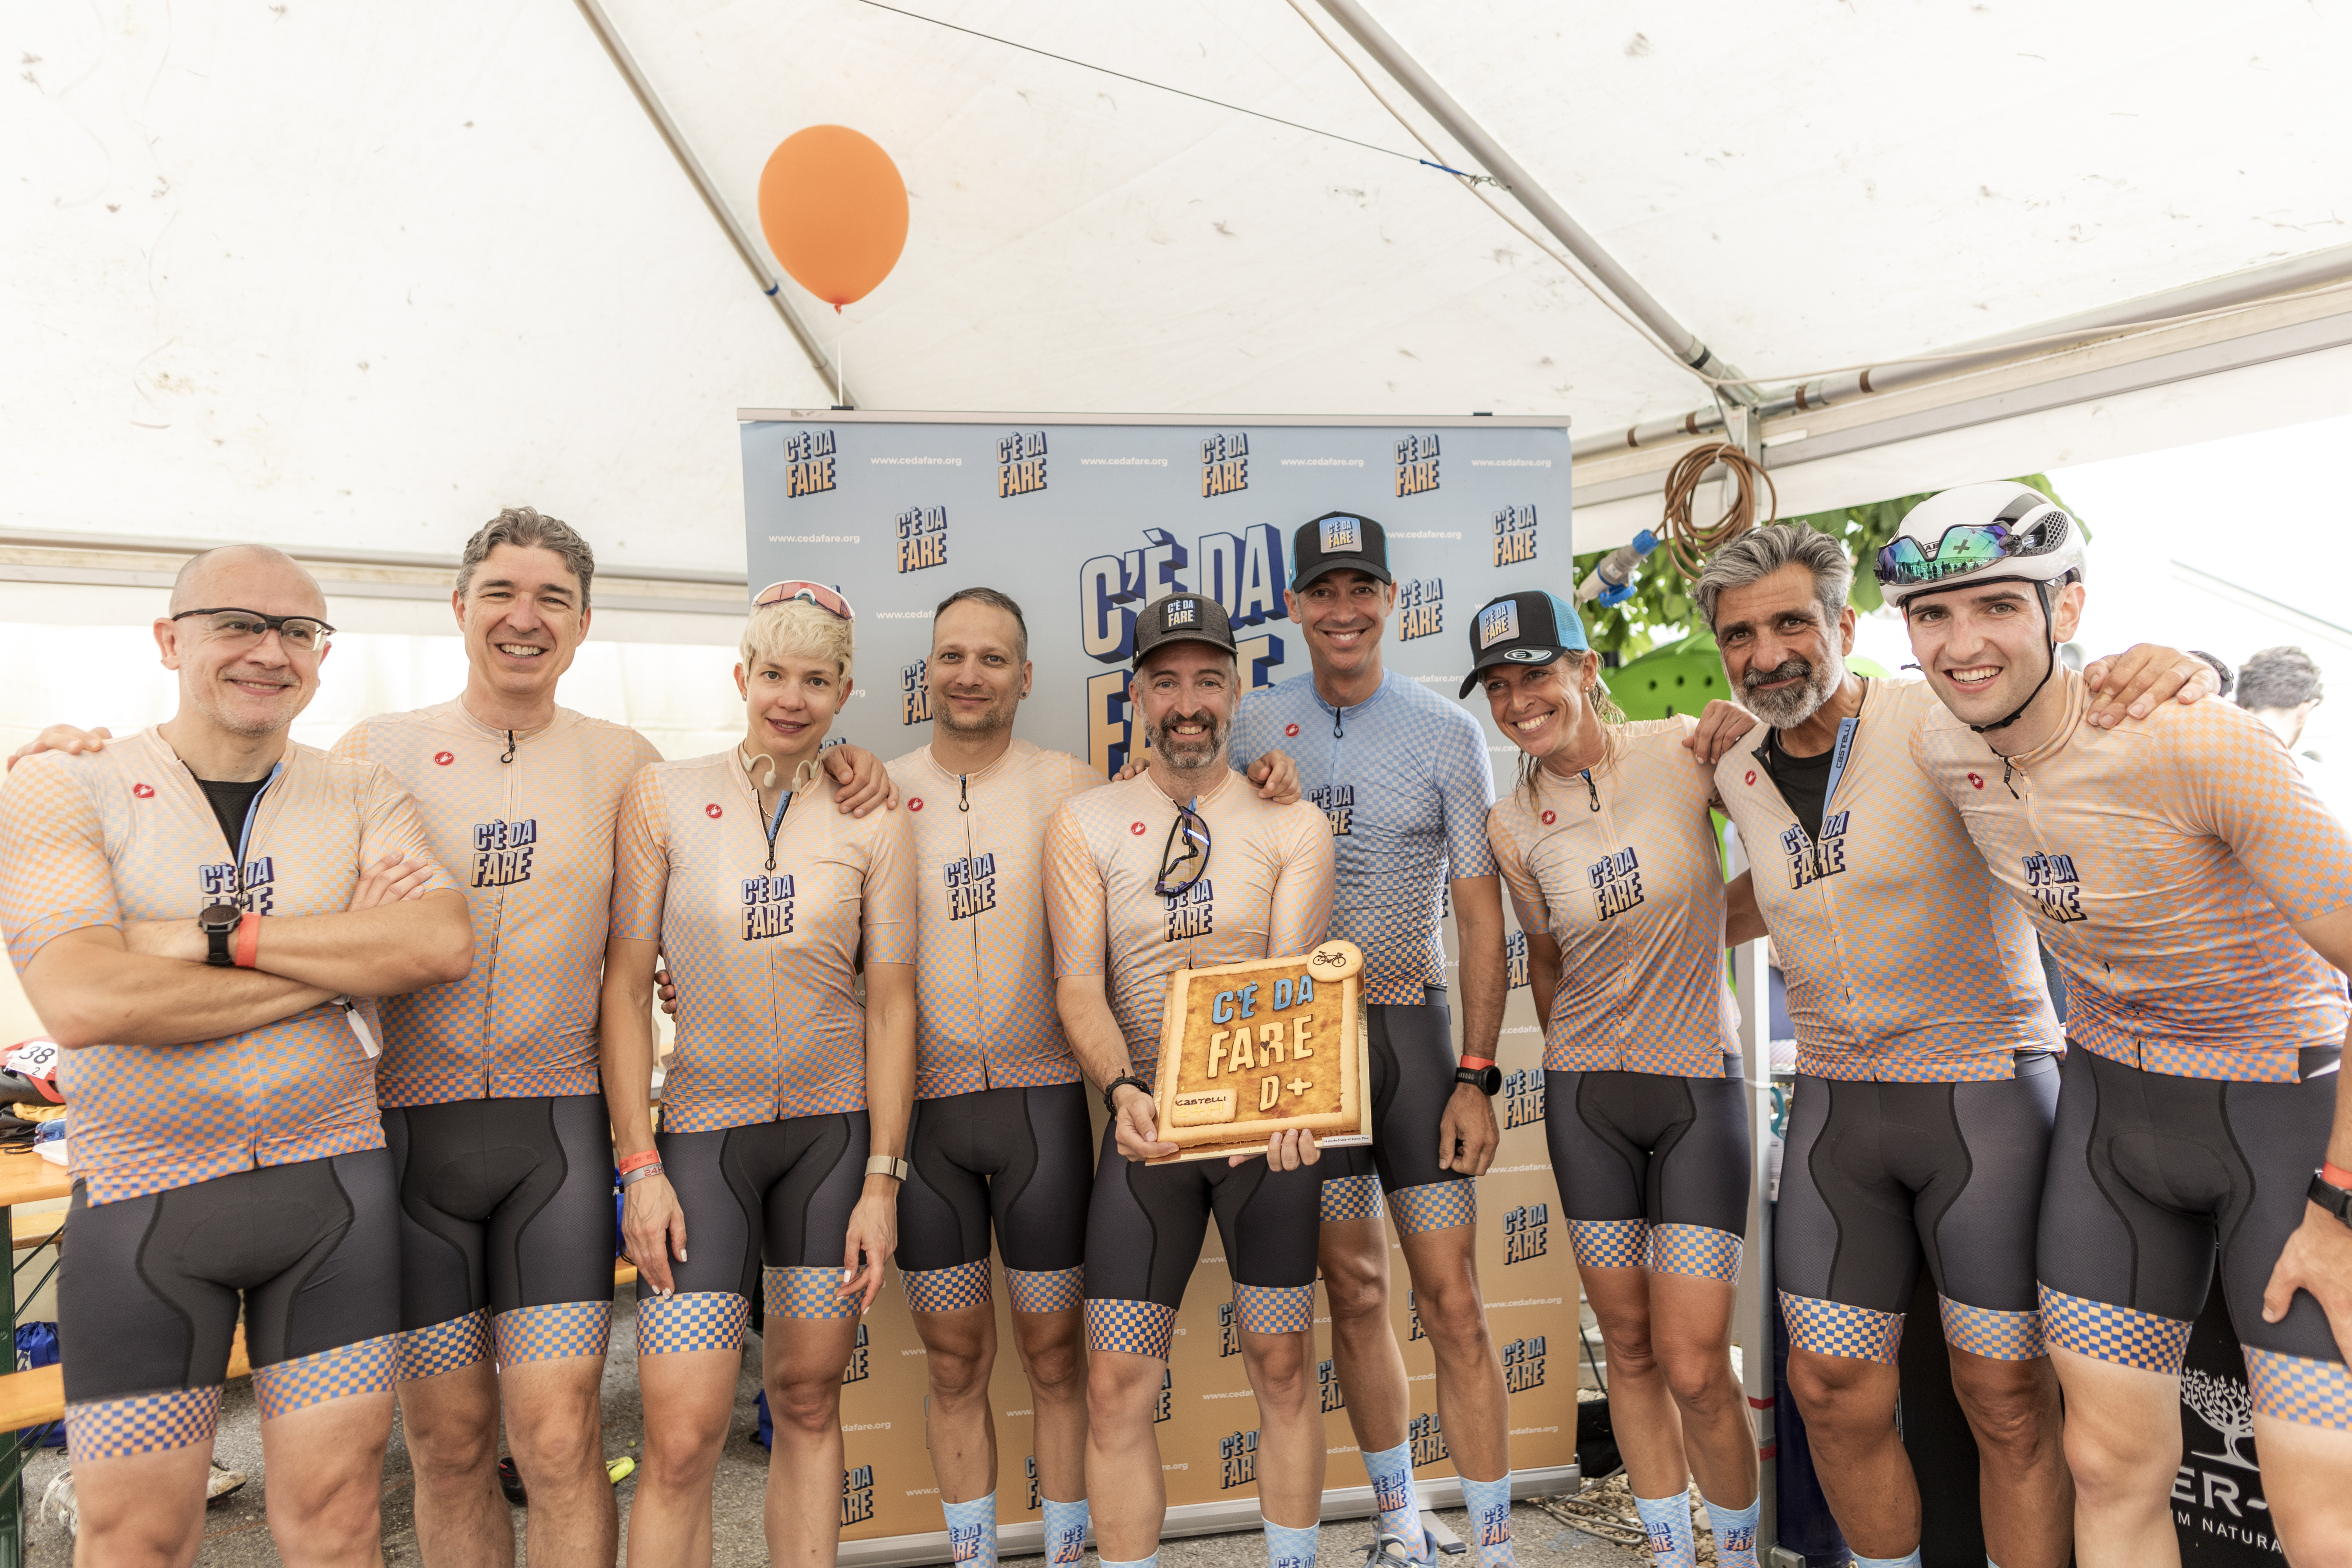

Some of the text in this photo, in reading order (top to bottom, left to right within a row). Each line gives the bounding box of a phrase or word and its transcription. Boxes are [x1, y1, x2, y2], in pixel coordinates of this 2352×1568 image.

[783, 429, 836, 462] C'È DA
[871, 456, 962, 466] www.cedafare.org
[996, 431, 1047, 464] C'È DA
[1201, 432, 1249, 464] C'È DA
[1394, 433, 1440, 464] C'È DA
[1081, 457, 1168, 466] www.cedafare.org
[1281, 458, 1364, 467] www.cedafare.org
[1472, 458, 1552, 467] www.cedafare.org
[786, 457, 836, 498] FARE
[999, 457, 1047, 498] FARE
[1202, 458, 1248, 498] FARE
[1396, 458, 1440, 497] FARE
[895, 505, 947, 539] C'È DA
[1328, 520, 1353, 535] C'È DA
[1492, 504, 1537, 535] C'È DA
[769, 534, 860, 544] www.cedafare.org
[897, 532, 947, 573] FARE
[1328, 531, 1353, 548] FARE
[1493, 529, 1537, 567] FARE
[1199, 522, 1290, 632] DA
[1168, 599, 1195, 613] C'È DA
[1398, 578, 1443, 609] C'È DA
[876, 610, 937, 618] www.cedafa
[1168, 609, 1195, 627] FARE
[1399, 603, 1443, 641] FARE
[1484, 605, 1508, 627] C'È DA
[1486, 617, 1509, 642] FARE
[1410, 673, 1464, 683] cedafare.org
[1334, 784, 1355, 807] DA
[474, 819, 537, 851] C'È DA
[1324, 808, 1353, 837] RE
[1780, 811, 1850, 855] C'È DA
[200, 857, 275, 894] C'È DA
[471, 847, 534, 888] FARE
[943, 853, 995, 888] C'È DA
[1588, 847, 1639, 889] C'È DA
[1787, 839, 1846, 890] FARE
[2022, 851, 2080, 886] C'È DA
[742, 875, 795, 905] C'È DA
[946, 878, 996, 921] FARE
[1191, 879, 1213, 904] DA
[1593, 872, 1644, 921] FARE
[742, 900, 793, 941] FARE
[1164, 904, 1212, 942] FARE
[1212, 974, 1313, 1024] C'È DA
[19, 1046, 55, 1064] 38
[1206, 1014, 1314, 1079] FARE
[32, 1067, 40, 1076] 2
[1503, 1067, 1545, 1098] C'È DA
[1175, 1101, 1224, 1117] 24H
[1504, 1090, 1545, 1130] FARE
[644, 1166, 664, 1177] 24H
[1503, 1203, 1548, 1234] C'È DA
[1503, 1226, 1547, 1265] FARE
[1484, 1297, 1562, 1309] www.cedafare.org
[1502, 1336, 1546, 1366] C'È DA
[1503, 1358, 1545, 1393] FARE
[841, 1422, 891, 1432] dafare.org
[1509, 1425, 1559, 1436] edafare.org
[1219, 1431, 1244, 1460] C'È
[851, 1465, 874, 1490] DA
[1390, 1469, 1405, 1488] DA
[2170, 1466, 2268, 1517] ER-
[840, 1489, 874, 1528] ARE
[1483, 1504, 1503, 1525] C'È
[961, 1523, 982, 1541] DA
[1061, 1525, 1083, 1544] C'È
[1482, 1518, 1510, 1546] FAR
[1649, 1522, 1671, 1535] DA
[1725, 1533, 1755, 1552] FAR
[2202, 1517, 2283, 1553] NATURA
[1054, 1541, 1086, 1564] FAR
